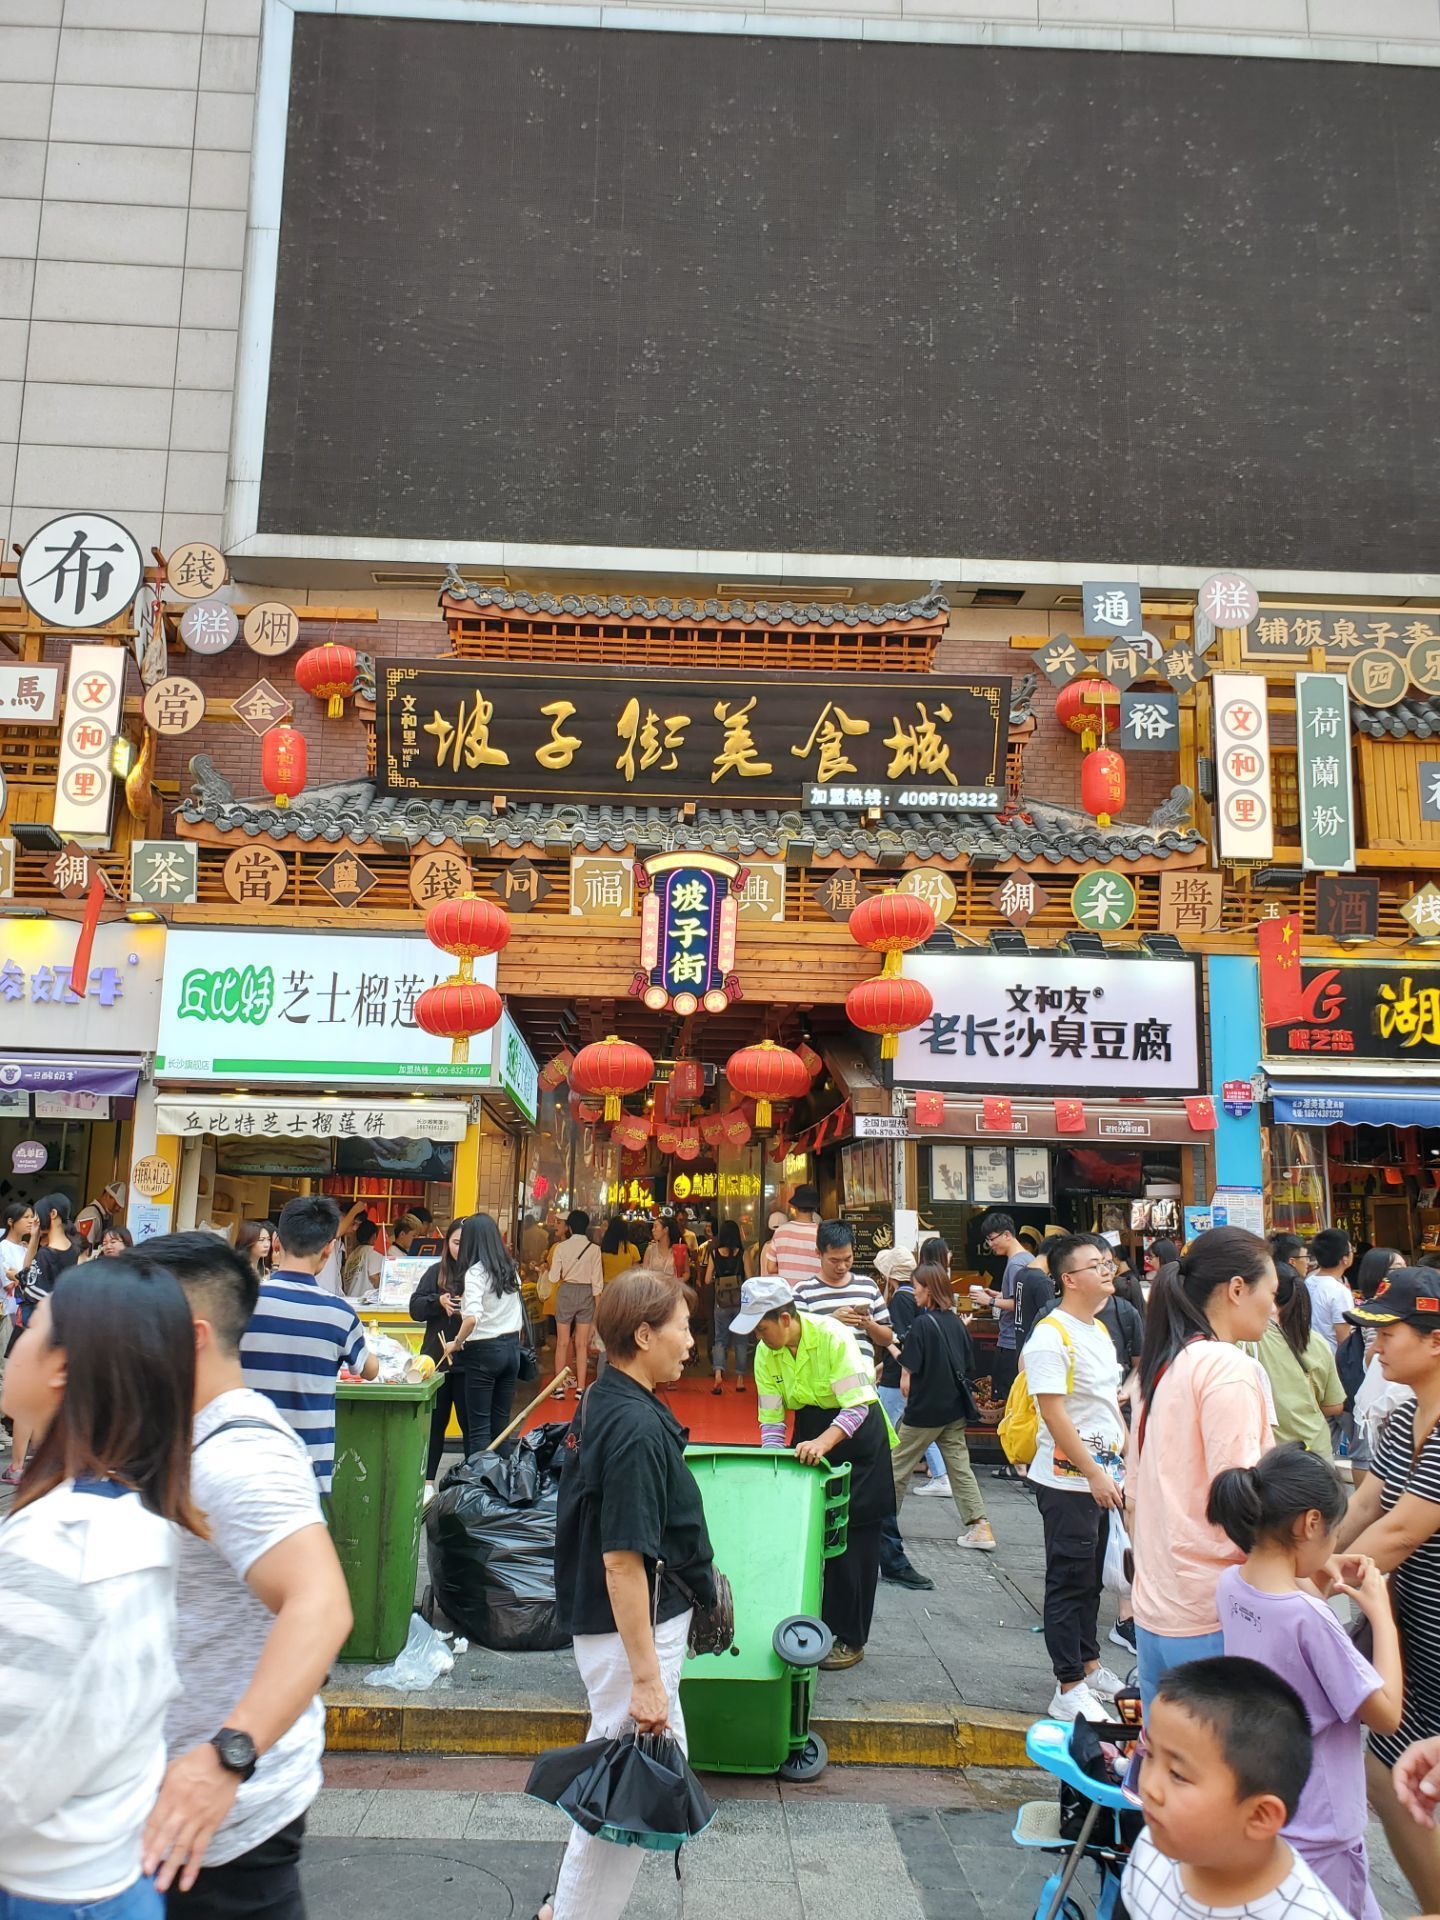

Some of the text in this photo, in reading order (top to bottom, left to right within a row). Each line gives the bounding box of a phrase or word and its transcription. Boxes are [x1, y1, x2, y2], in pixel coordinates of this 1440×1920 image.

[27, 529, 125, 615] 布
[175, 550, 218, 590] 錢
[1092, 590, 1134, 627] 通
[1205, 581, 1251, 620] 糕
[185, 607, 231, 646] 糕
[253, 610, 293, 648] 烟
[1044, 646, 1077, 675] 兴
[1106, 647, 1137, 678] 同
[1163, 649, 1198, 682] 戴
[1363, 658, 1397, 695] 园
[11, 675, 46, 712] 馬
[154, 683, 198, 729] 當
[240, 688, 284, 721] 金
[72, 677, 108, 797] 文和里
[400, 694, 418, 746] 文和里
[423, 688, 958, 787] 坡子街美食城
[1125, 702, 1176, 741] 裕
[1104, 753, 1122, 803] 文和里
[1229, 705, 1257, 823] 文和里
[1306, 706, 1346, 838] 荷蘭粉
[140, 851, 190, 898] 茶
[235, 851, 280, 901] 當
[416, 859, 462, 901] 錢
[505, 867, 541, 902] 同
[582, 868, 624, 908] 福
[1081, 876, 1125, 924] 杂
[1326, 884, 1372, 934] 酒
[668, 879, 710, 985] 坡子街
[181, 968, 274, 1022] 丘比特
[1006, 983, 1092, 1015] 文和友
[1377, 976, 1440, 1048] 湖
[919, 1013, 1173, 1062] 老长沙臭豆腐
[183, 1111, 386, 1136] 丘比特芝士榴莲饼
[863, 1118, 909, 1128] 全国加盟热
